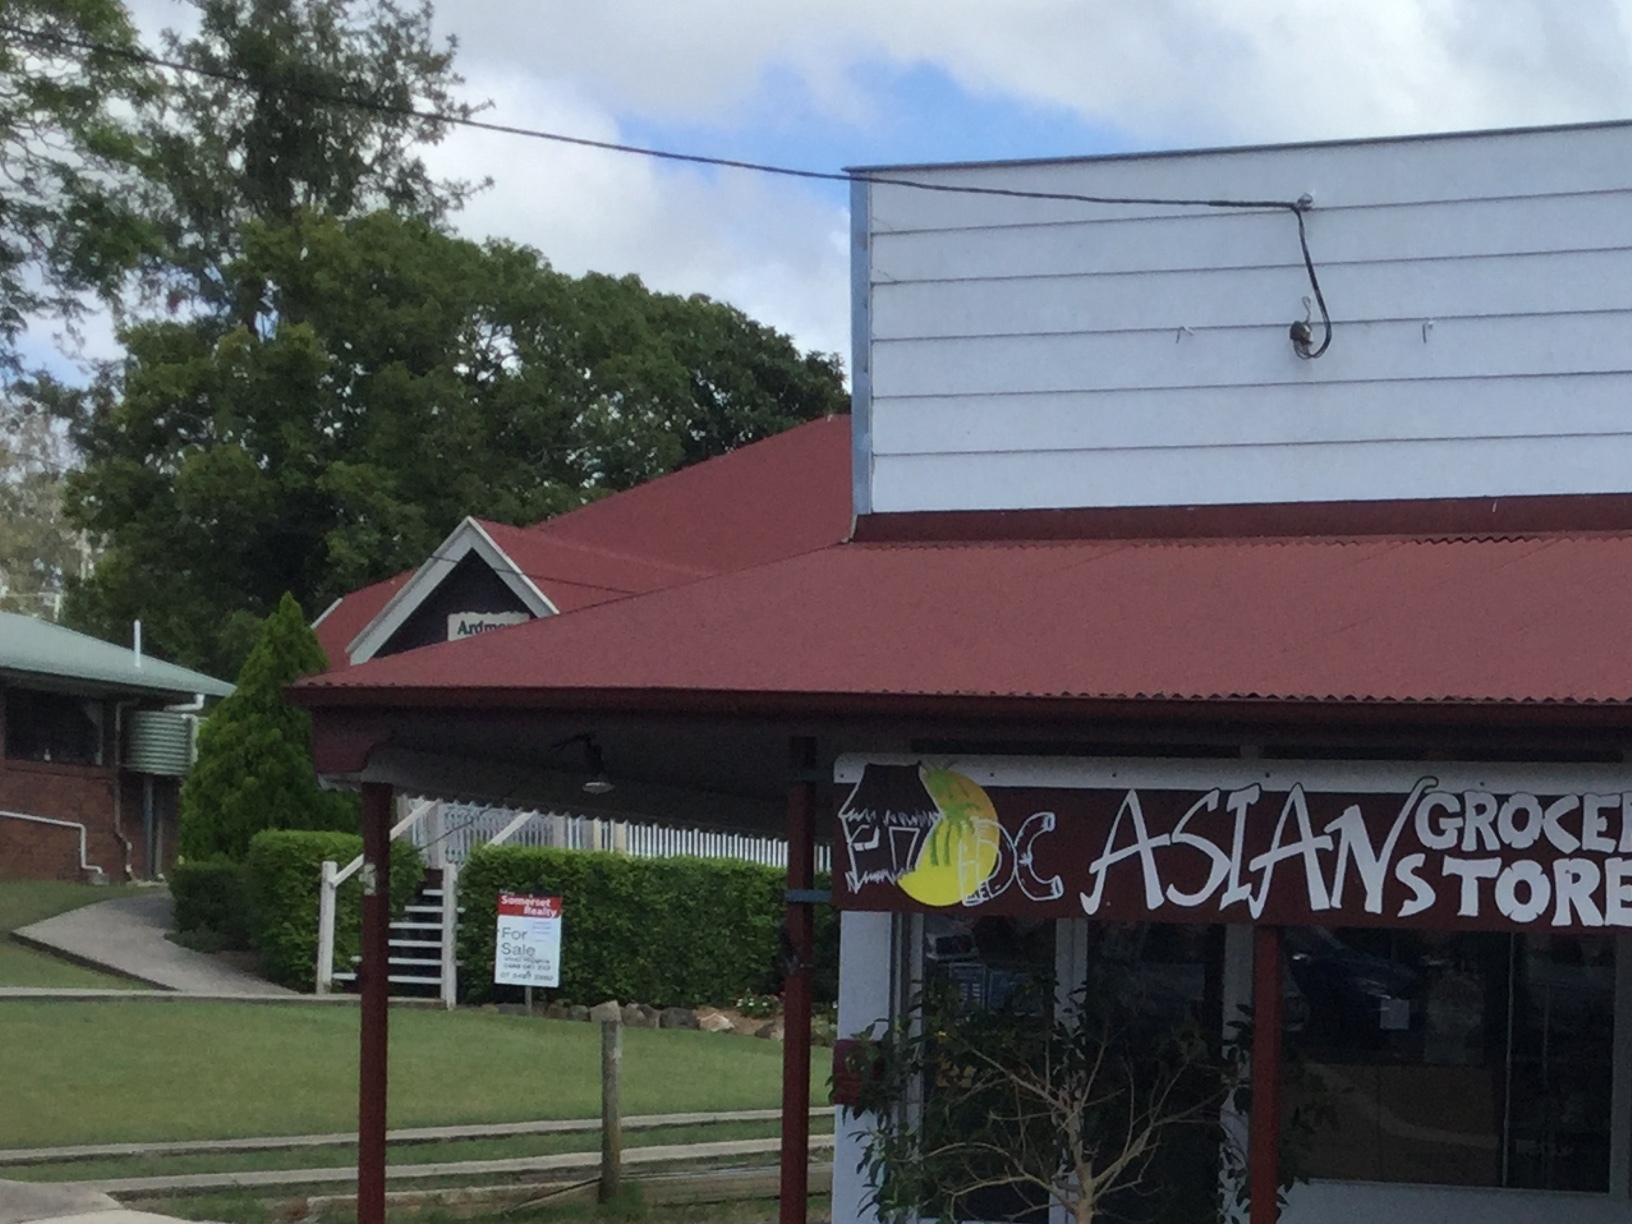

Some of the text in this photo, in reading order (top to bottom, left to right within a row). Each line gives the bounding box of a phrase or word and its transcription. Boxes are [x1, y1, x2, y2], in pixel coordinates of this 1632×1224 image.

[457, 620, 511, 635] Ardm
[1080, 776, 1439, 919] ASIAN
[501, 895, 552, 907] Somerset
[524, 906, 558, 917] Realty
[501, 927, 528, 940] For
[501, 942, 536, 957] Sale
